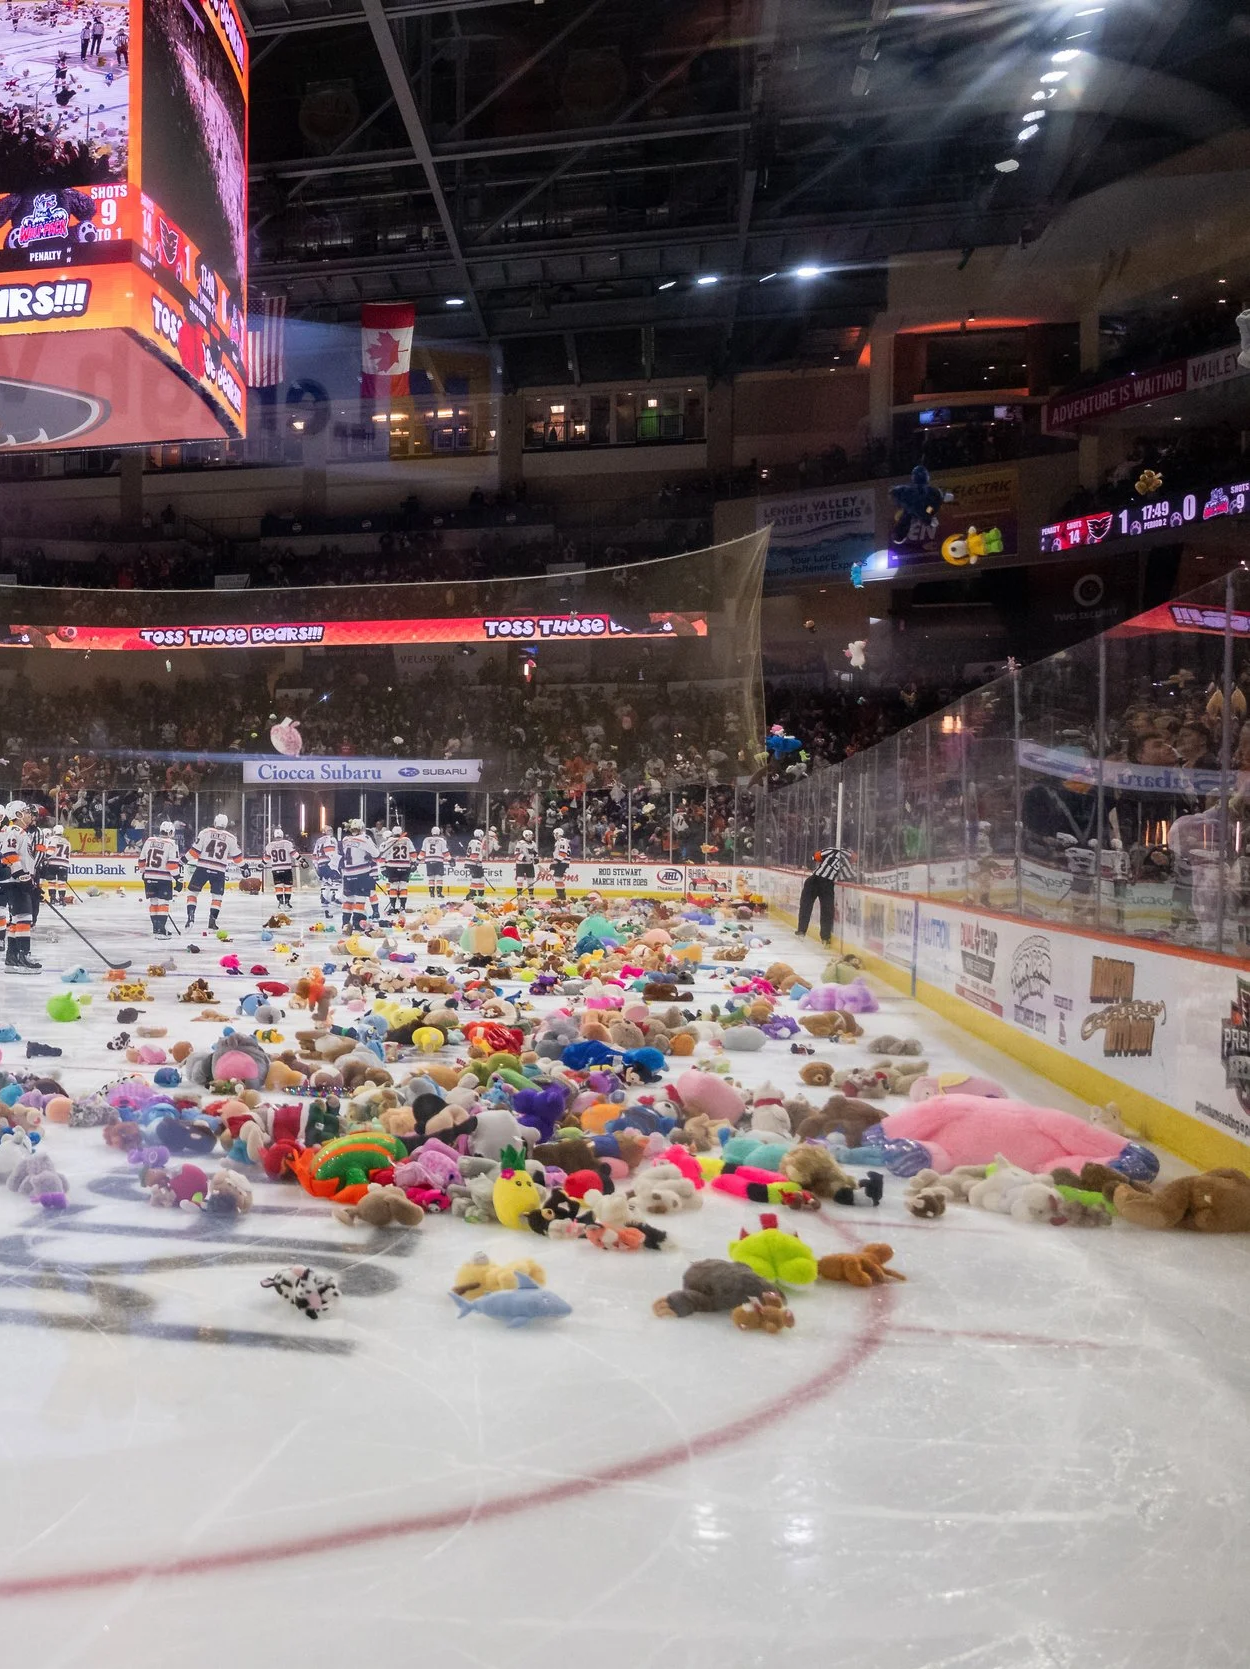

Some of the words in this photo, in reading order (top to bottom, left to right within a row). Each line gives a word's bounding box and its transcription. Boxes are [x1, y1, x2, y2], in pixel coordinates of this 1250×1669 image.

[91, 184, 127, 199] SHOTS
[101, 199, 116, 225] 9
[29, 250, 62, 262] PENALTY
[1052, 389, 1116, 425] ADVENTURE
[1119, 384, 1130, 401] IS
[1133, 370, 1182, 398] WAITING
[813, 496, 858, 511] VALLEY
[806, 508, 861, 524] SYSTEMS
[1119, 509, 1128, 534] 1
[1142, 501, 1169, 520] 17:49
[1183, 494, 1196, 520] 0
[1069, 529, 1080, 544] 14
[258, 763, 315, 780] Ciocca
[321, 763, 382, 780] Subaru
[422, 768, 467, 776] SUBARU
[56, 841, 70, 859] 74
[205, 840, 227, 859] 43
[271, 849, 286, 862] 90
[393, 846, 407, 859] 23
[429, 844, 436, 854] 5
[146, 849, 164, 868] 15
[67, 864, 94, 875] ulton
[95, 864, 126, 875] Bank
[613, 868, 642, 876] STEWART
[662, 871, 680, 881] AHL
[592, 877, 614, 886] MARCH
[616, 877, 631, 886] 14TH
